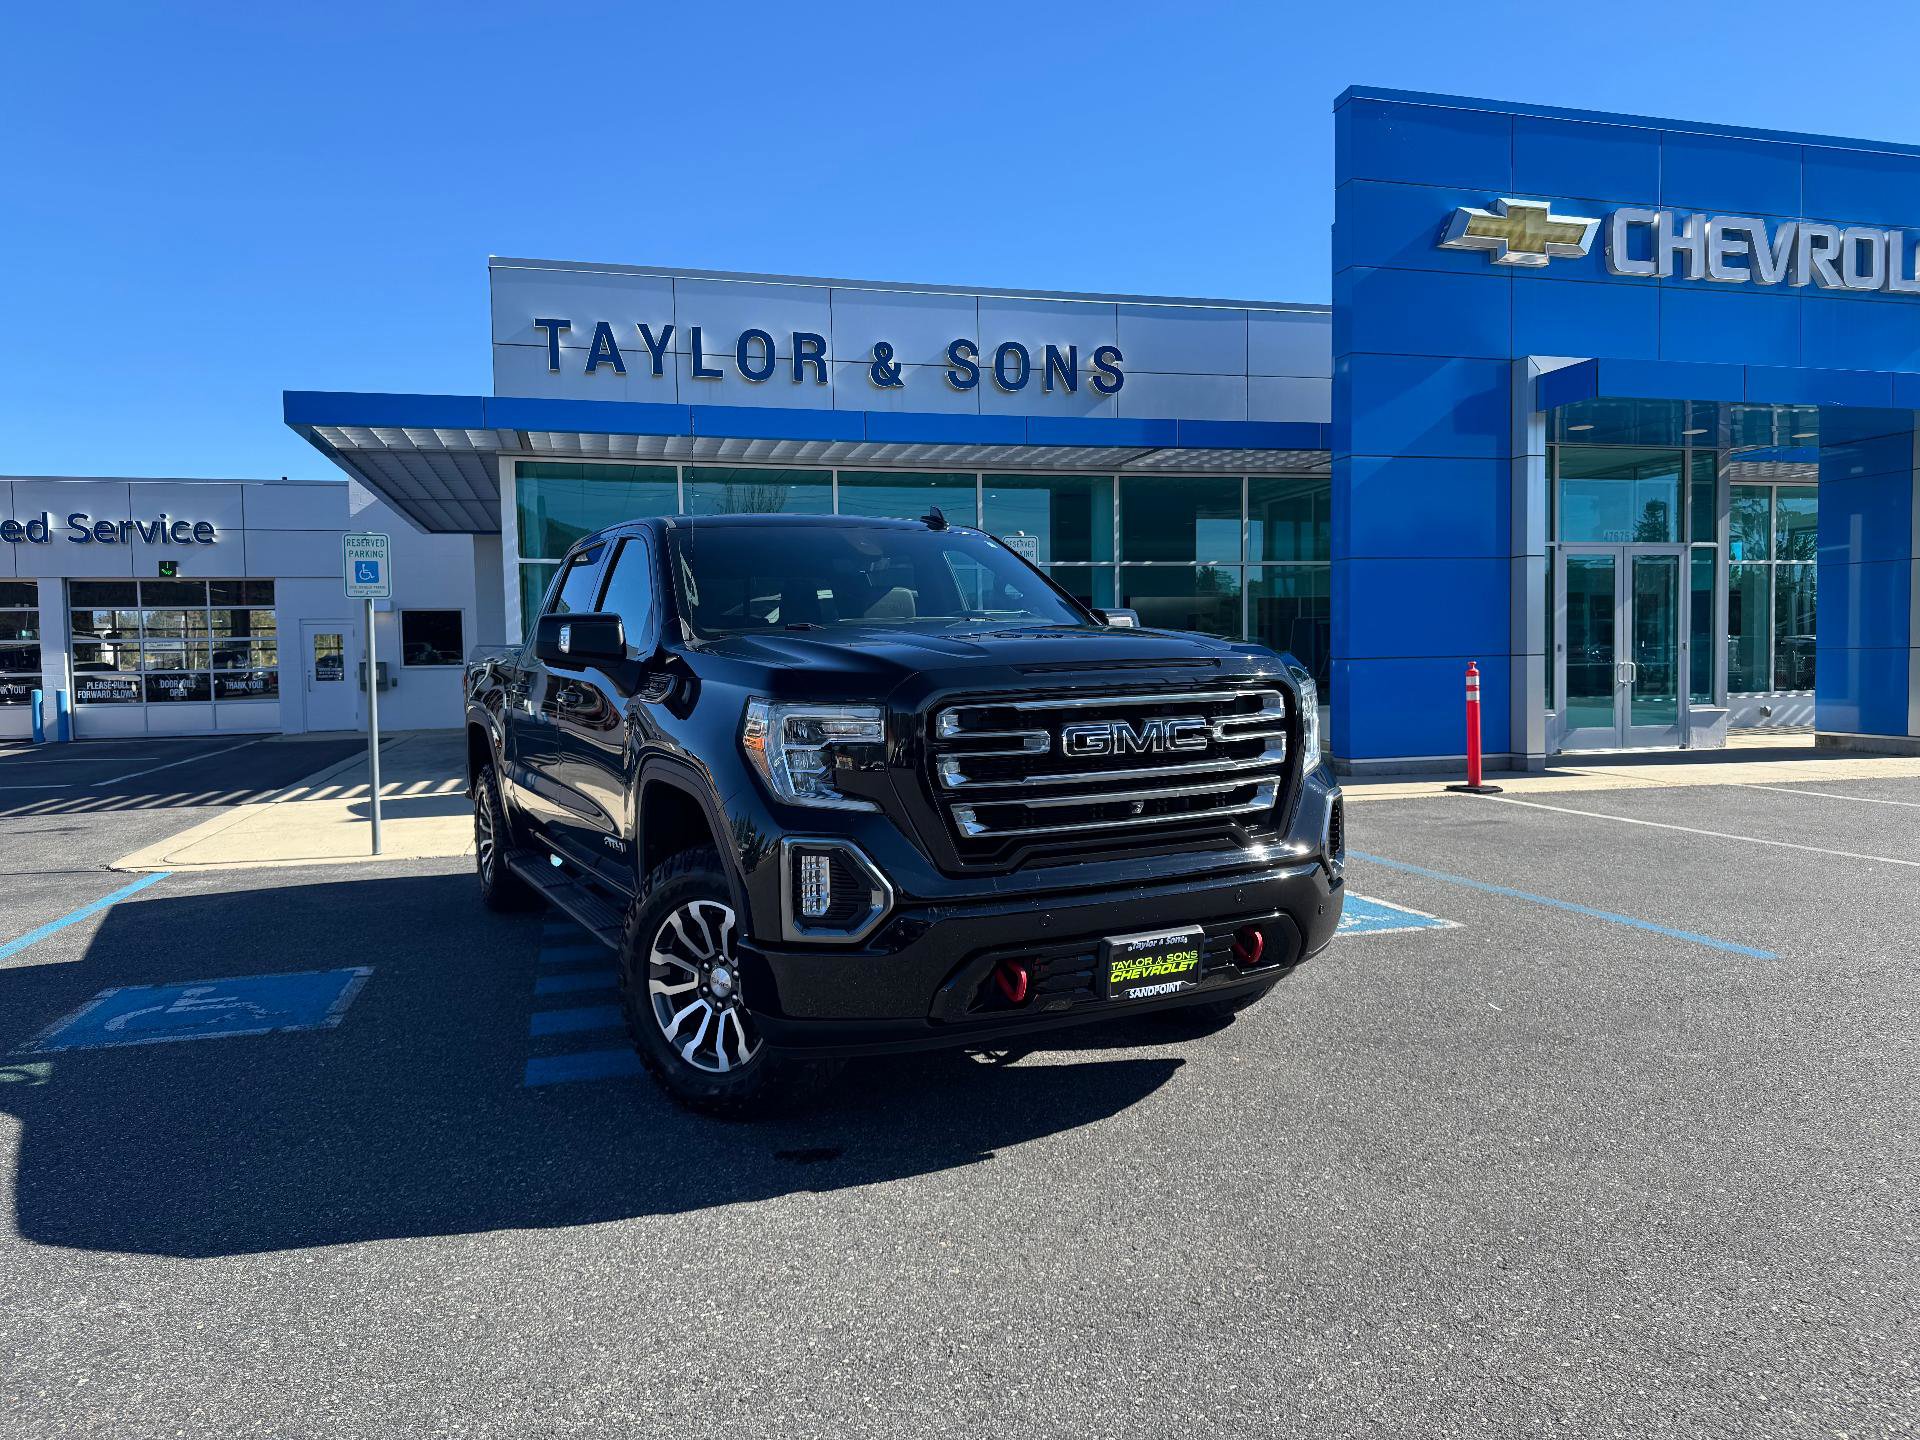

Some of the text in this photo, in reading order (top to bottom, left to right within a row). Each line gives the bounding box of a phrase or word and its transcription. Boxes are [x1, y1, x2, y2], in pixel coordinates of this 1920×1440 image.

[1606, 207, 1920, 292] CHEVROL
[533, 318, 1126, 394] TAYLOR & SONS
[0, 512, 216, 544] ed Service
[346, 538, 385, 548] RESERVED
[348, 550, 384, 558] PARKING
[9, 685, 26, 694] YOU!
[86, 680, 130, 690] PLEASE PULL
[160, 680, 179, 688] DOOR
[225, 681, 263, 689] THANK YOU!
[78, 689, 138, 699] FORWARD SLOWLY
[169, 689, 188, 697] OPEN
[1062, 717, 1208, 757] GMC
[1132, 939, 1158, 950] Taylor
[1165, 935, 1186, 945] Sons
[1112, 950, 1198, 971] TAYLOR & SONS
[1110, 961, 1197, 983] CHEVROLET
[1129, 982, 1181, 998] SANDPOINT
